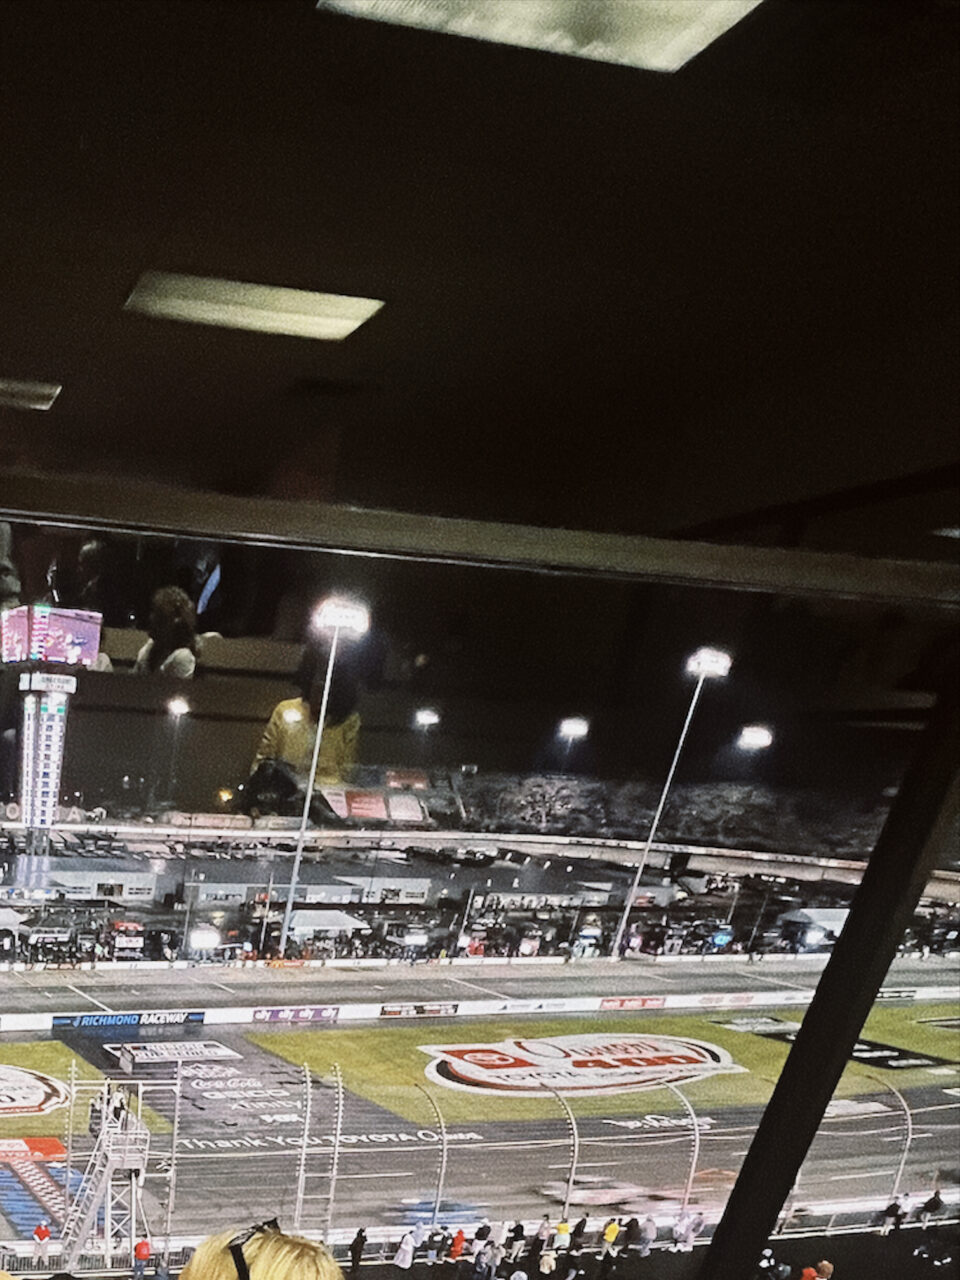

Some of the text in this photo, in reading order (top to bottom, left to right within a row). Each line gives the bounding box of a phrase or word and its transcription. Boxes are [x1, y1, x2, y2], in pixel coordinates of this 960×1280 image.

[81, 1013, 188, 1026] RICHMOND RACEWAY
[176, 1135, 268, 1150] Thank
